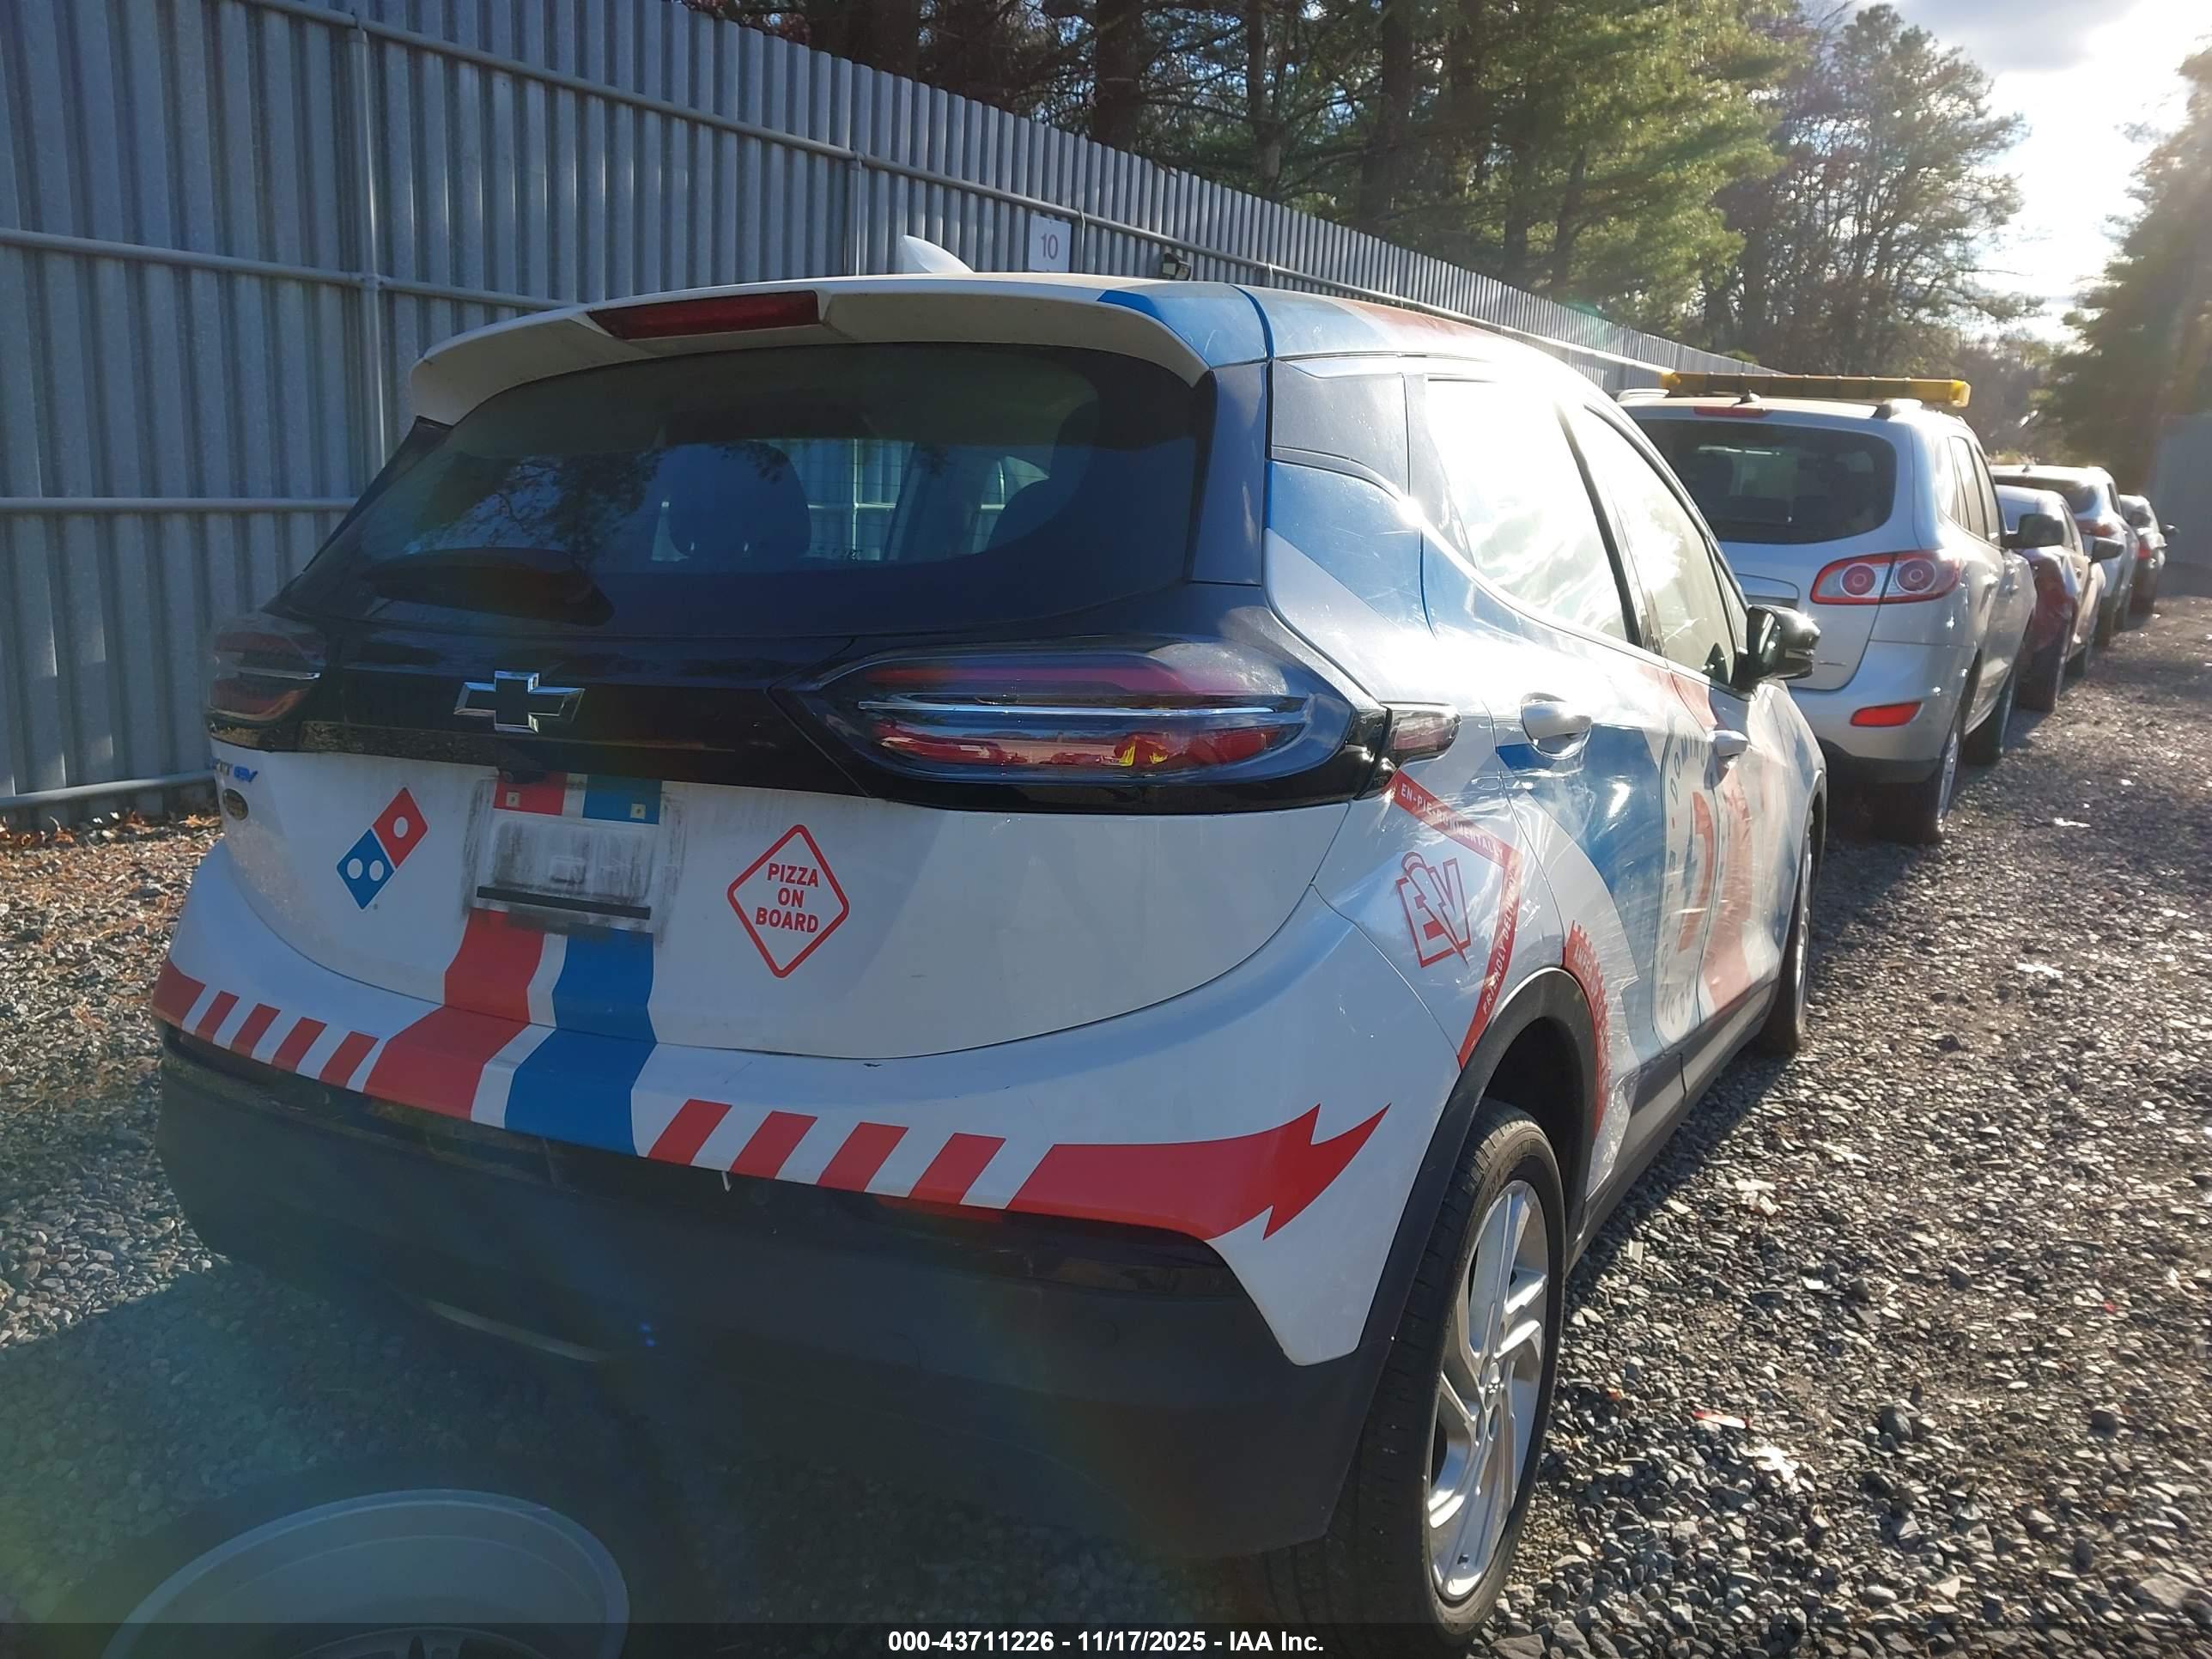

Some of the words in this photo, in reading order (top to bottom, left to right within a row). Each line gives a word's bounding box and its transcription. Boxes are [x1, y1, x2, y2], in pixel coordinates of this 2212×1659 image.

[1041, 234, 1059, 260] 10
[767, 863, 819, 888] PIZZA
[778, 888, 805, 908] ON
[755, 907, 819, 934] BOARD
[1482, 940, 1507, 1015] FRIENDLY
